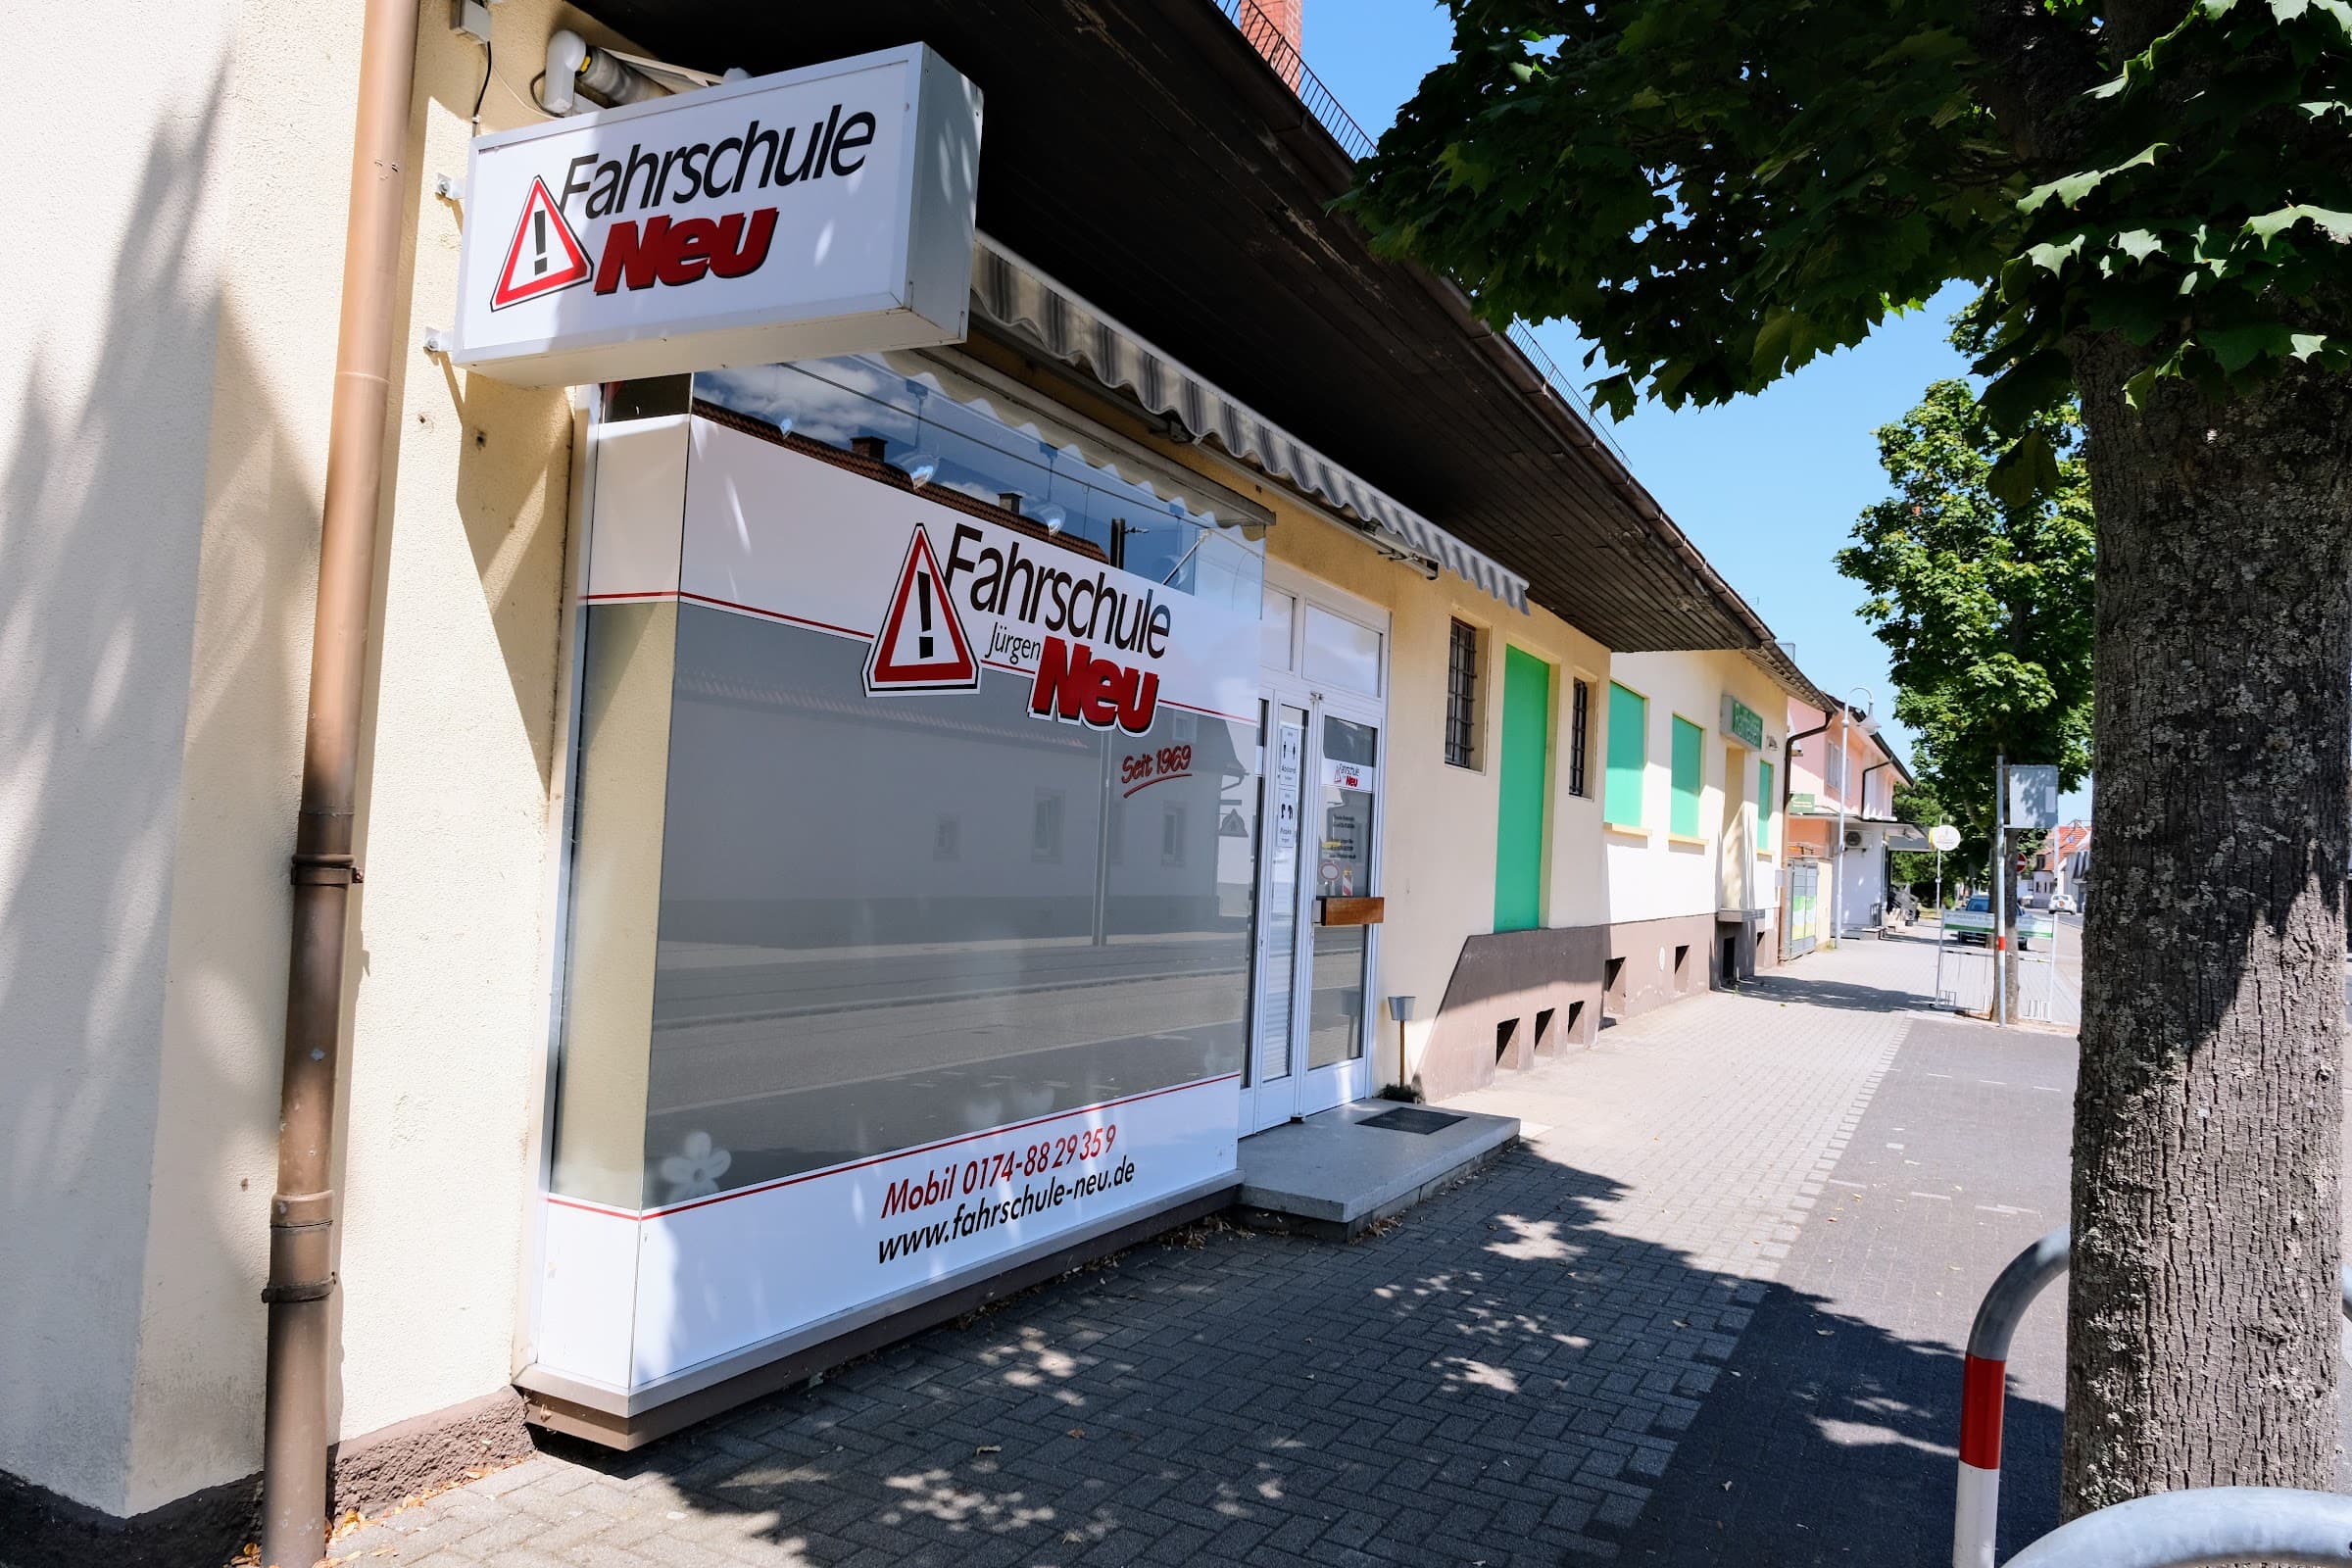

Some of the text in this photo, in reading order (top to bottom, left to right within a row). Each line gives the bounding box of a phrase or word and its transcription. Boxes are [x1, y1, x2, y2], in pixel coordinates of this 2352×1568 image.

[560, 104, 876, 220] Fahrschule
[593, 207, 779, 295] Neu
[945, 522, 1171, 660] Fahrschule
[985, 622, 1041, 664] Jürgen
[1028, 635, 1160, 733] Neu
[1121, 745, 1192, 784] Seit 1969
[878, 1154, 1135, 1264] www.fahrschule-neu.de
[881, 1163, 956, 1219] Mobil
